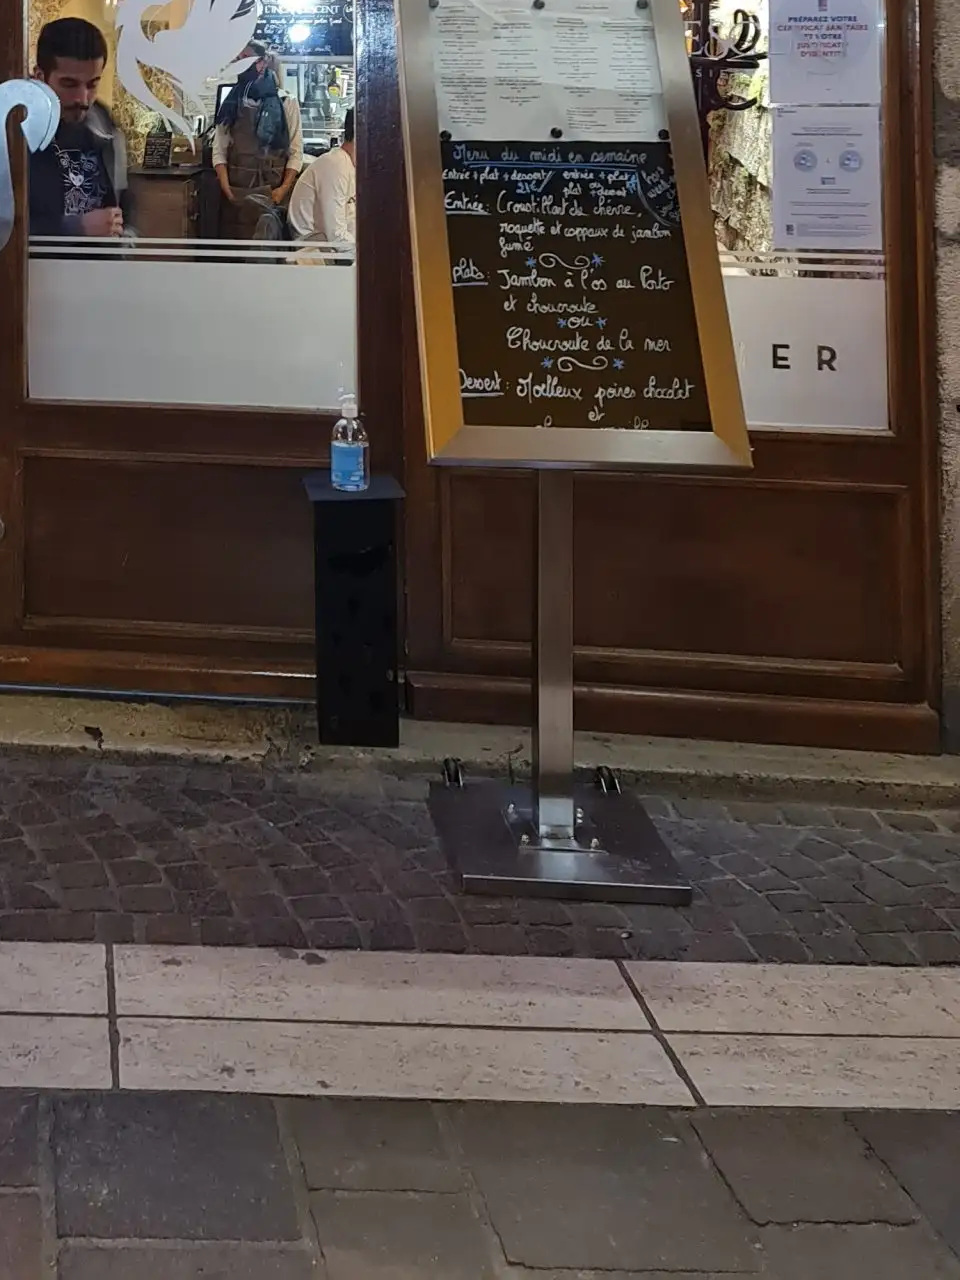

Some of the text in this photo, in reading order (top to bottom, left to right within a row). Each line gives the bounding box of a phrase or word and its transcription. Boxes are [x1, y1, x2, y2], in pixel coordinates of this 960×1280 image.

[788, 15, 829, 23] PRÉPAREZ
[452, 144, 648, 164] Menu du midi en semaine
[480, 166, 500, 184] plat
[562, 181, 582, 198] plat
[496, 190, 568, 216] Croustillant
[569, 199, 587, 216] de
[499, 217, 545, 242] roquette
[550, 219, 563, 236] et
[613, 222, 626, 238] de
[630, 222, 672, 243] jambon
[499, 236, 534, 259] fumé
[498, 269, 556, 290] Jambon
[564, 271, 574, 288] à
[581, 269, 608, 291] l'os
[616, 278, 636, 290] au
[639, 266, 675, 291] Porto
[503, 292, 599, 314] et choucroute
[506, 326, 672, 352] Choucroute de la mer
[595, 384, 636, 407] poires
[643, 376, 695, 400] chocolat
[588, 406, 605, 422] et
